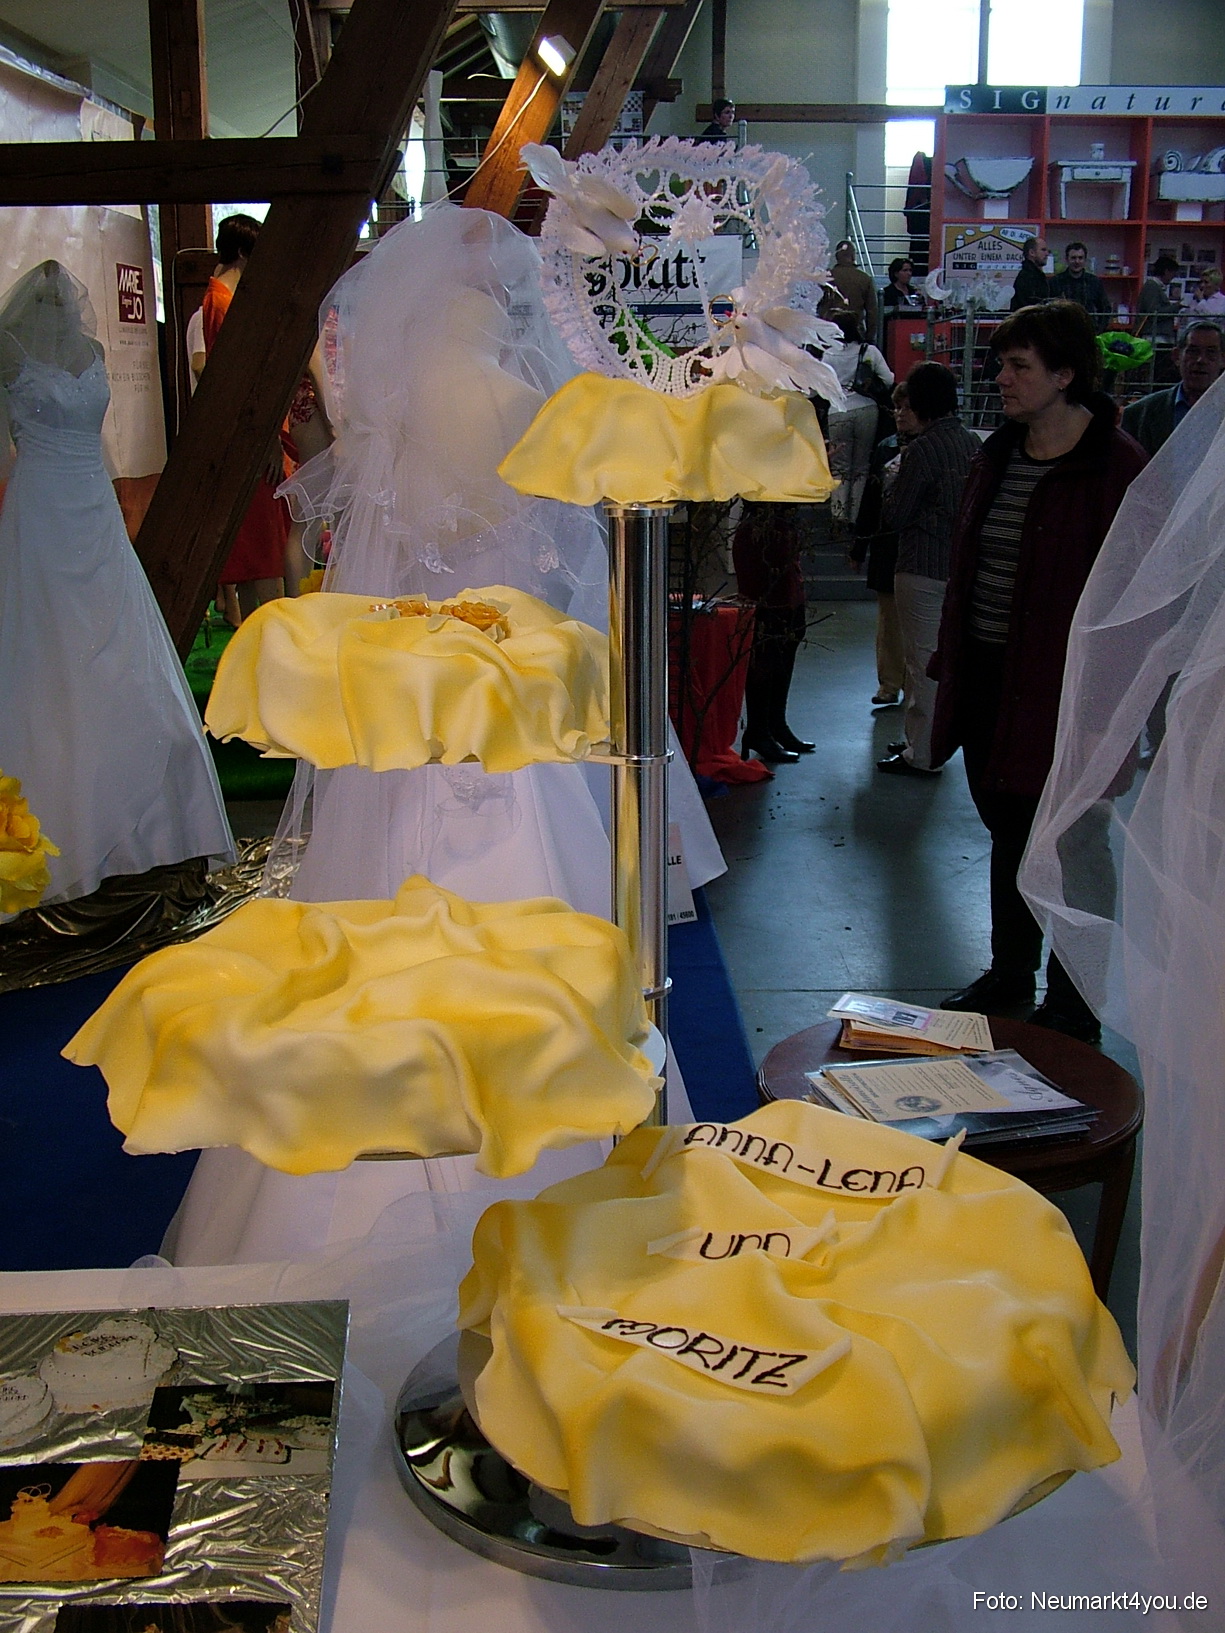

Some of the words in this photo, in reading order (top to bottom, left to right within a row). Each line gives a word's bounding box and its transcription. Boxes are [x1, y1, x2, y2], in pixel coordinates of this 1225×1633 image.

[978, 241, 1003, 250] ALLES
[953, 252, 977, 260] UNTER
[981, 252, 1002, 261] EINEM
[127, 296, 143, 320] JO
[601, 1318, 808, 1388] MORITZ
